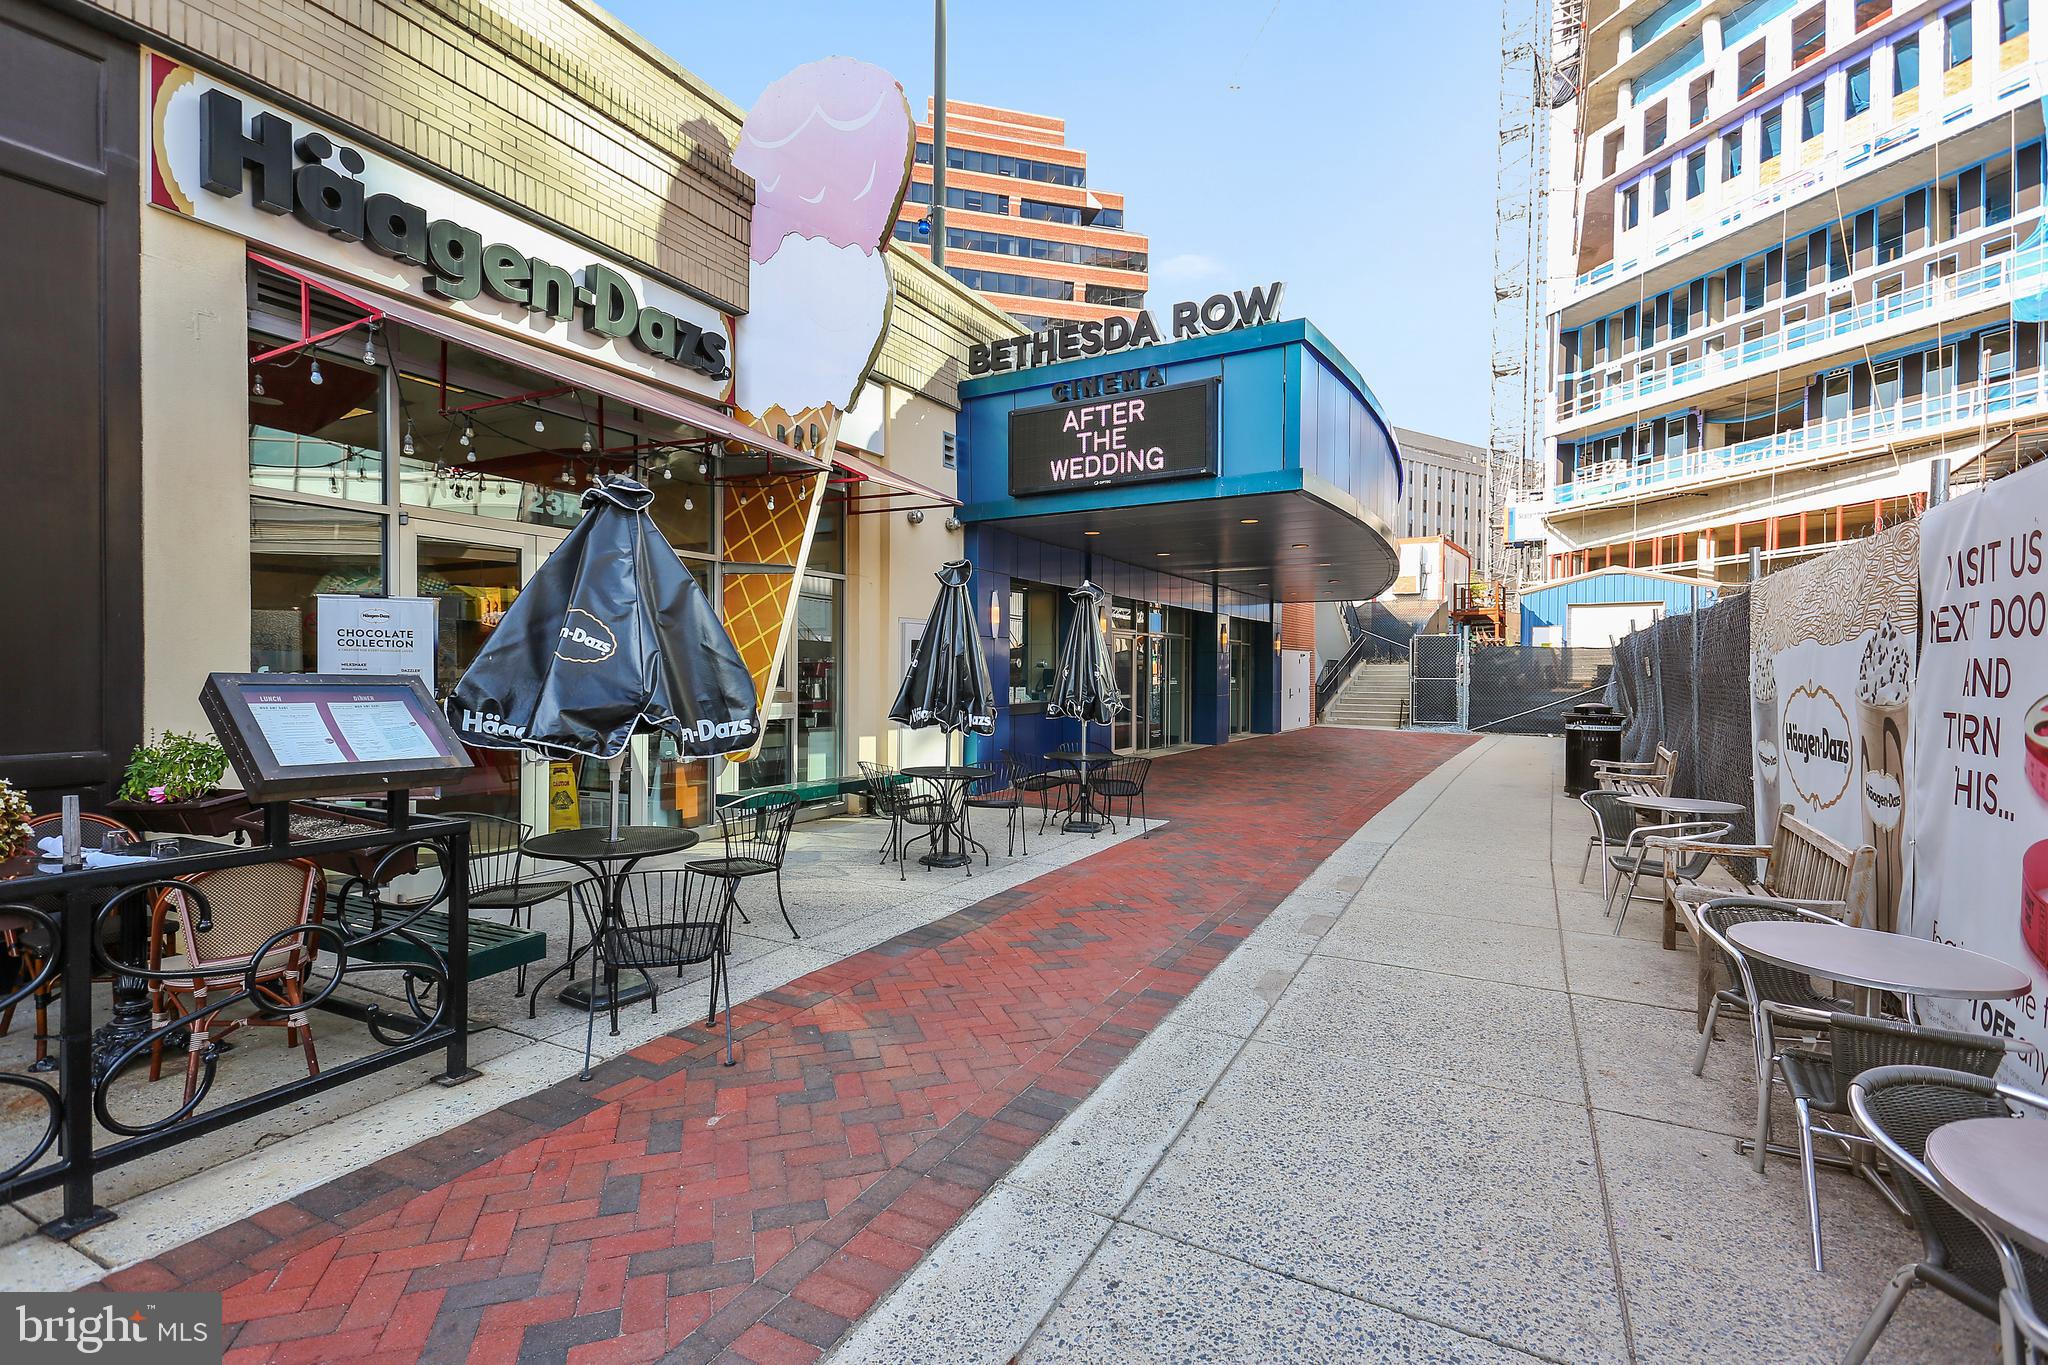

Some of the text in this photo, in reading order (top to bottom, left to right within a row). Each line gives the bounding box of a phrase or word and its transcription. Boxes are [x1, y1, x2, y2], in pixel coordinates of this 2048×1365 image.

[200, 88, 728, 379] Häagen-Dazs
[968, 281, 1283, 376] BETHESDA ROW
[1052, 367, 1165, 402] CINEMA
[1063, 399, 1145, 433] AFTER
[1076, 427, 1127, 454] THE
[1050, 446, 1164, 482] WEDDING
[2010, 530, 2043, 578] US
[337, 629, 414, 639] CHOCOLATE
[337, 639, 414, 648] COLLECTION
[1785, 722, 1850, 764] Häagen-Dazs
[1954, 765, 2015, 822] HIS...
